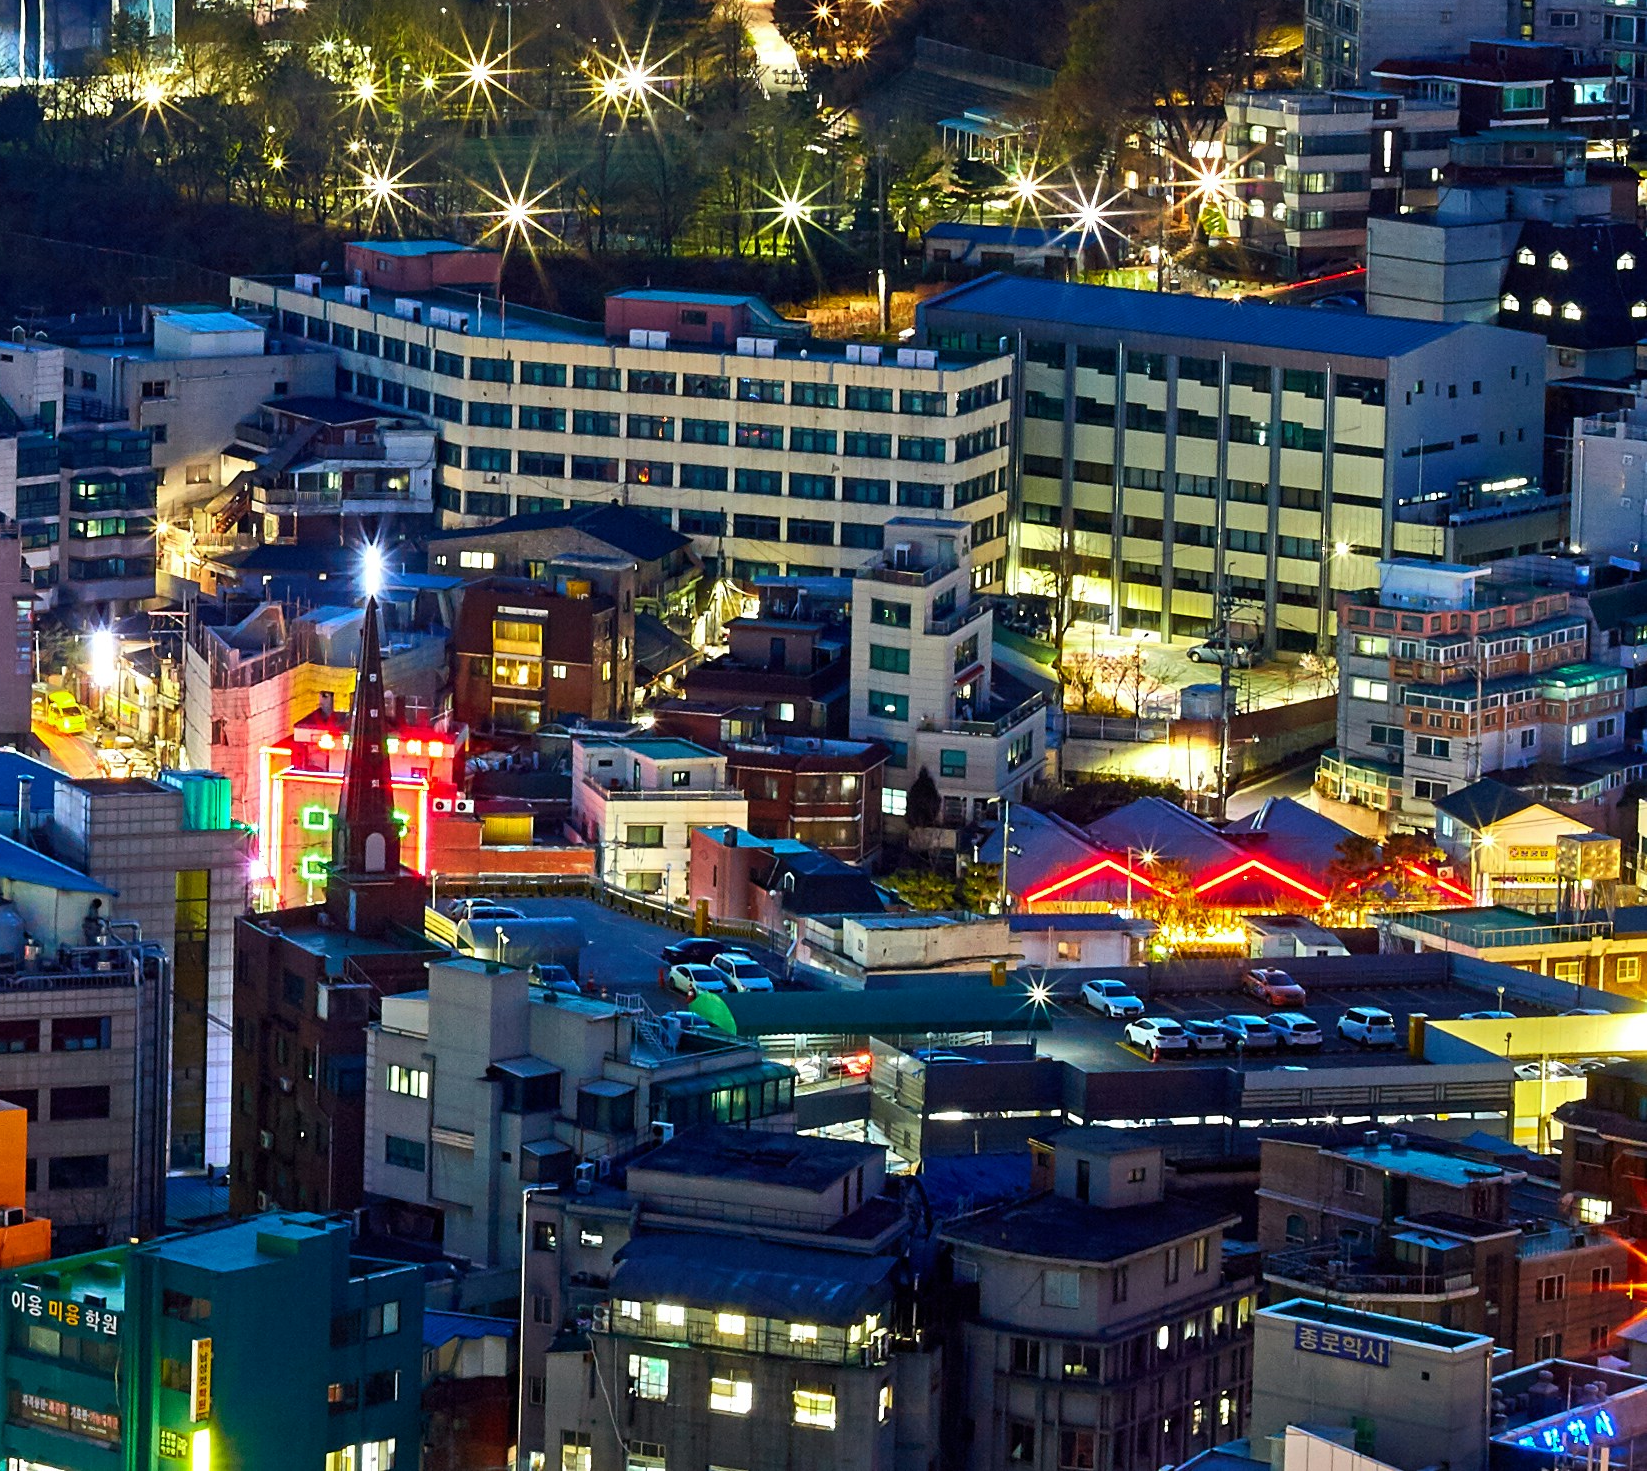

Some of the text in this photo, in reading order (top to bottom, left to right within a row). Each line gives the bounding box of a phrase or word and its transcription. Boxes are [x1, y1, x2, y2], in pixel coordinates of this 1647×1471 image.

[11, 1290, 118, 1336] 이용 미용 학원
[1299, 1327, 1385, 1363] 종로학사
